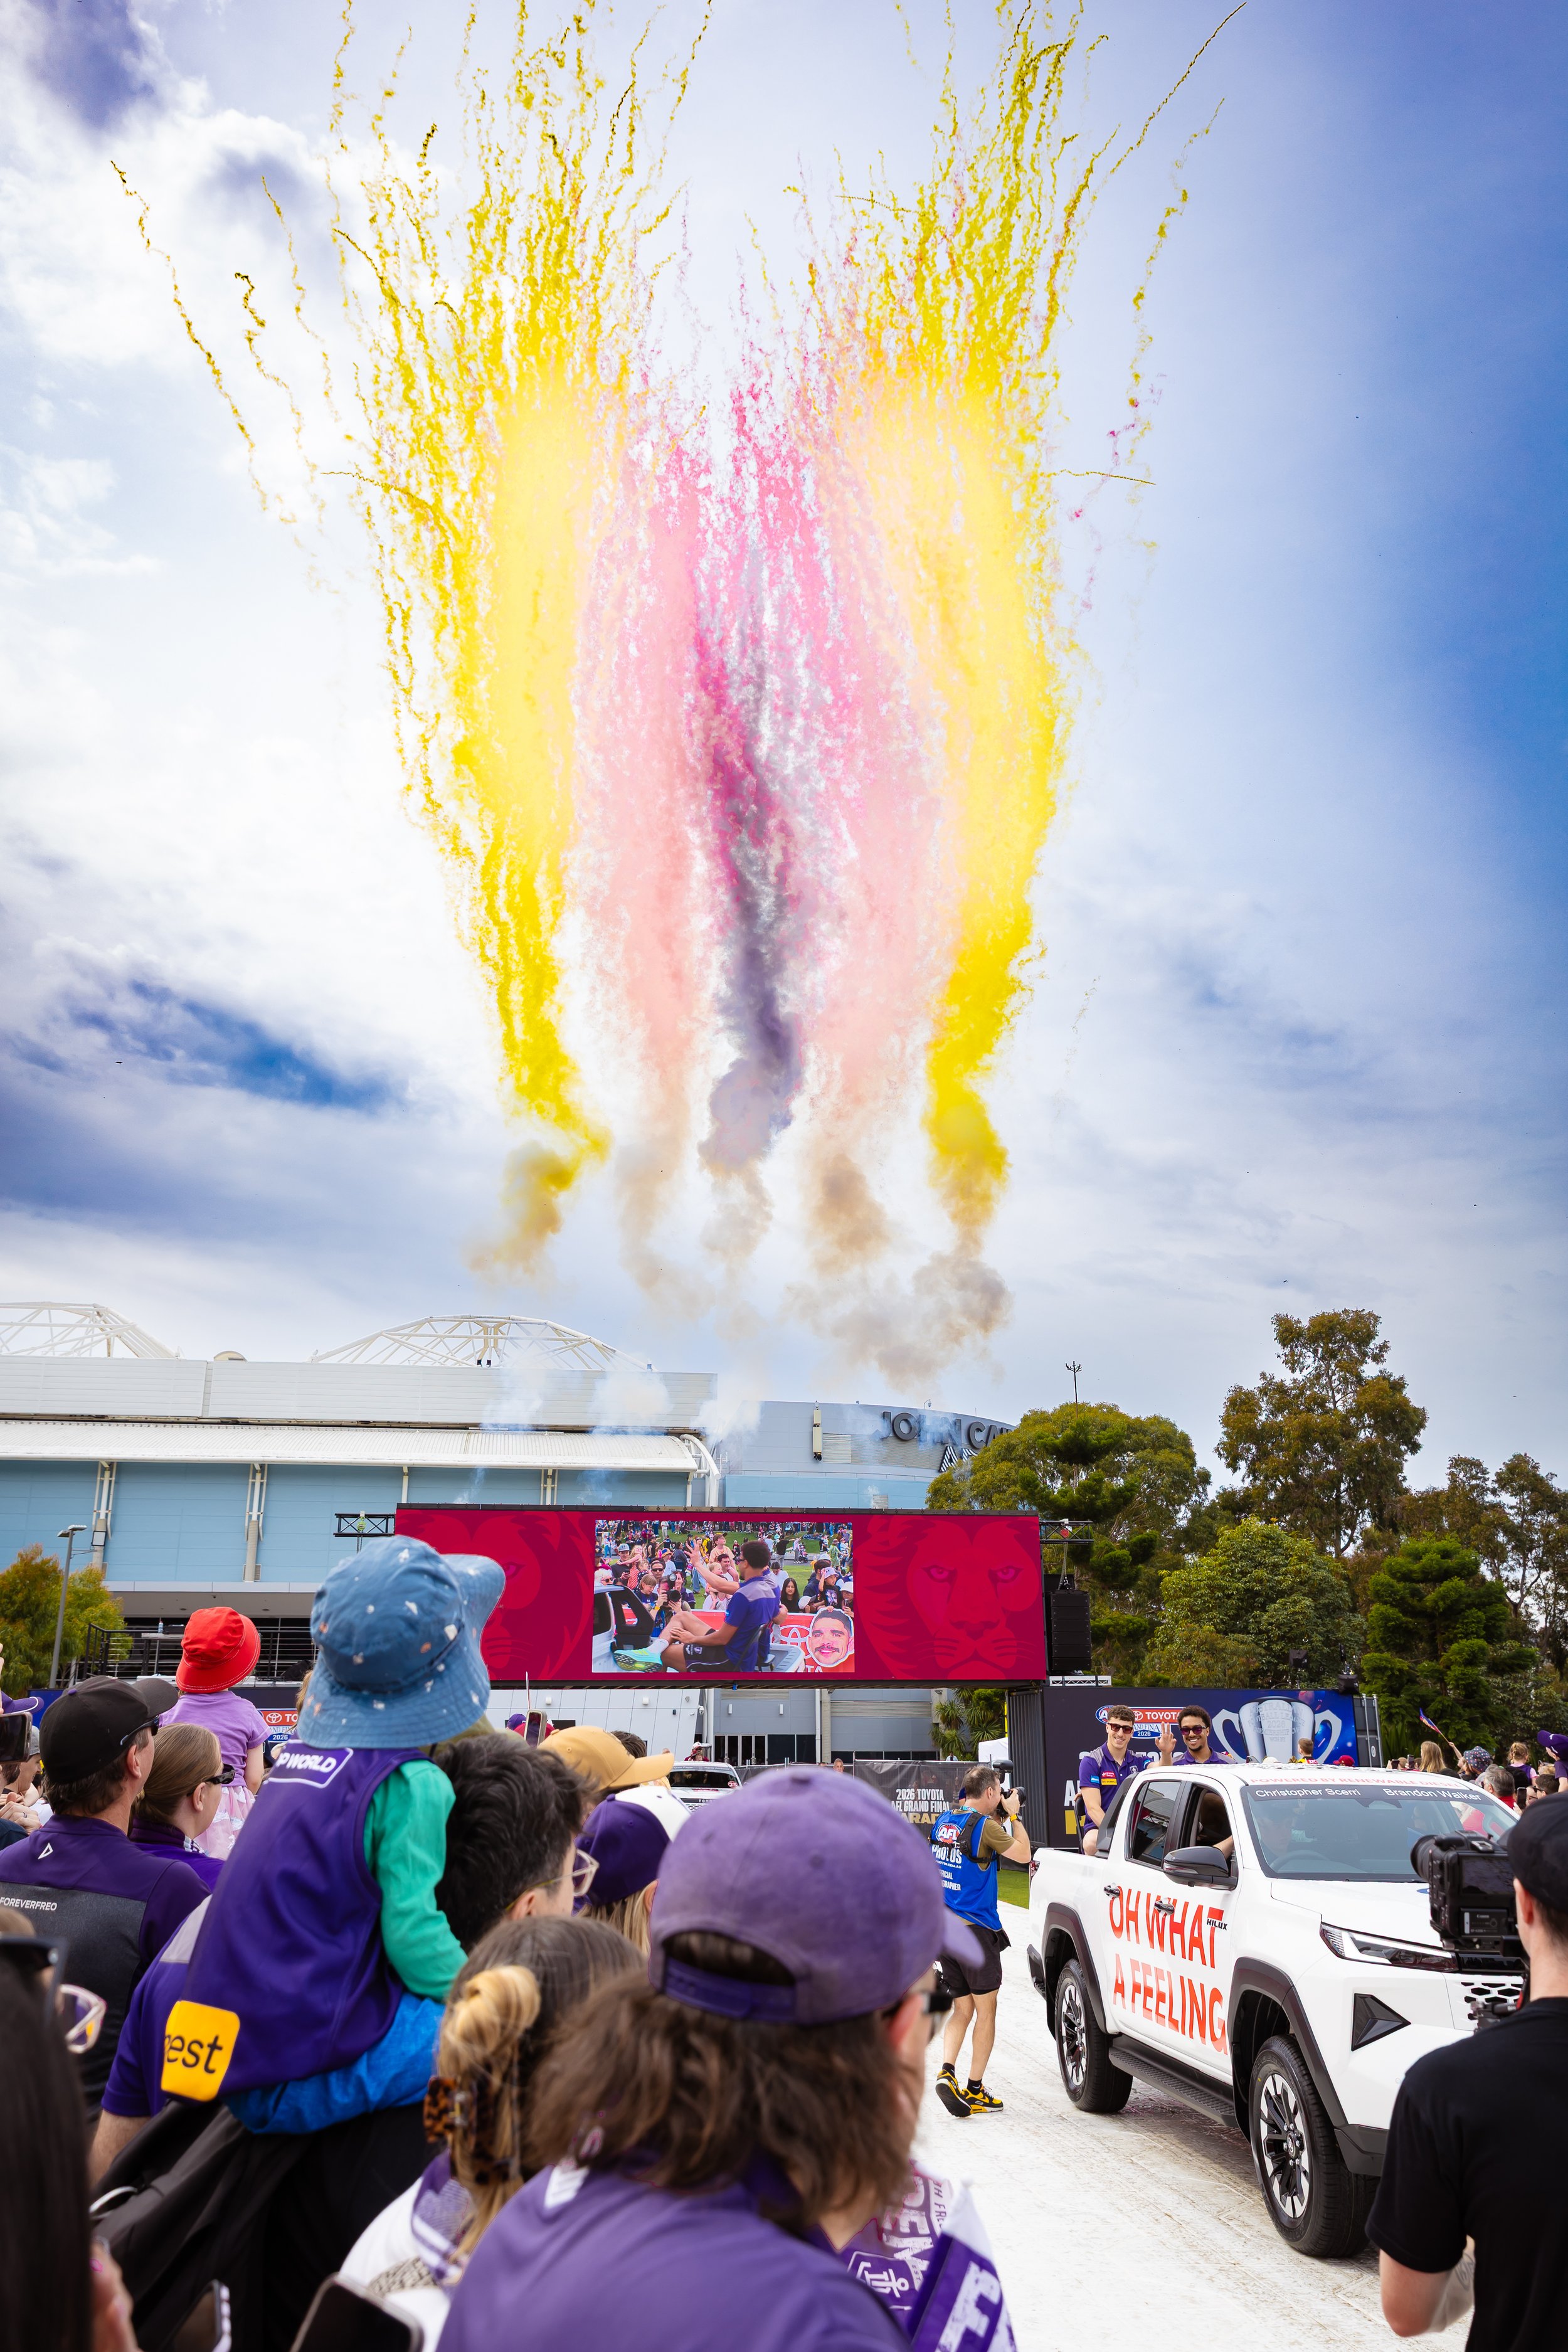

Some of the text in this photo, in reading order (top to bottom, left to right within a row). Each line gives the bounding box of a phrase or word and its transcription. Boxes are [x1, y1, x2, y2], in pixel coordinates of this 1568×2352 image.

[880, 1411, 1012, 1449] JOHN CA
[1145, 1724, 1160, 1732] FINA
[896, 1788, 944, 1801] 2026 TOYOTA
[1255, 1788, 1323, 1797] Christopher
[1382, 1788, 1438, 1798] Brandon
[1436, 1790, 1482, 1801] Walker
[891, 1801, 903, 1812] AFL
[903, 1801, 929, 1812] GRAND
[938, 1827, 958, 1840] AFL
[941, 1879, 961, 1891] GRAPHER
[1110, 1885, 1224, 1969] OH WHAT
[1206, 1918, 1227, 1931] HILUX
[1113, 1953, 1228, 2056] A FEELING
